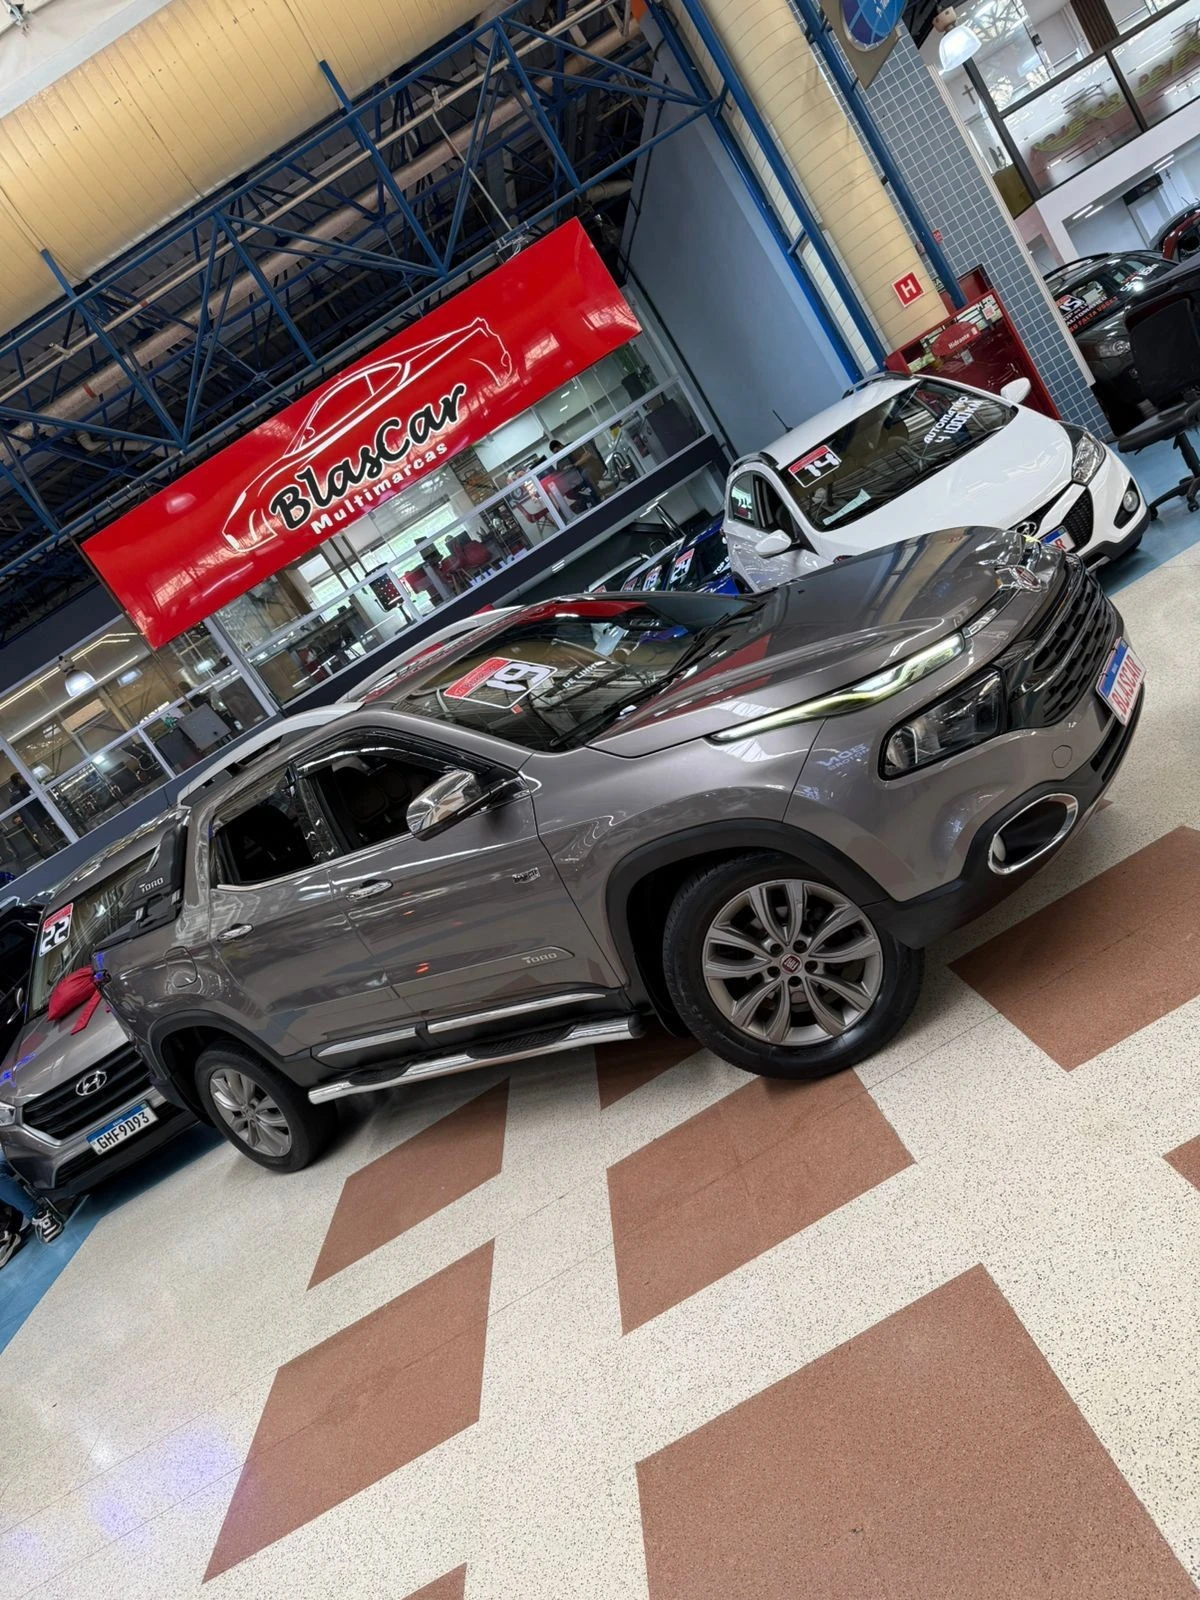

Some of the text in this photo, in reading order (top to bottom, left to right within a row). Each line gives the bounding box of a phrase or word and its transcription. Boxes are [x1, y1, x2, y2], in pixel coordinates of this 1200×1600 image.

[900, 279, 917, 298] H
[269, 382, 467, 531] BlasCar
[804, 452, 840, 477] 14
[310, 442, 448, 535] Multimarcas
[486, 662, 551, 692] 19
[1112, 654, 1142, 715] BLASCAR
[139, 877, 164, 893] TORO
[42, 915, 70, 953] 22
[521, 952, 558, 964] TORO
[97, 1111, 150, 1149] GHF9D93
